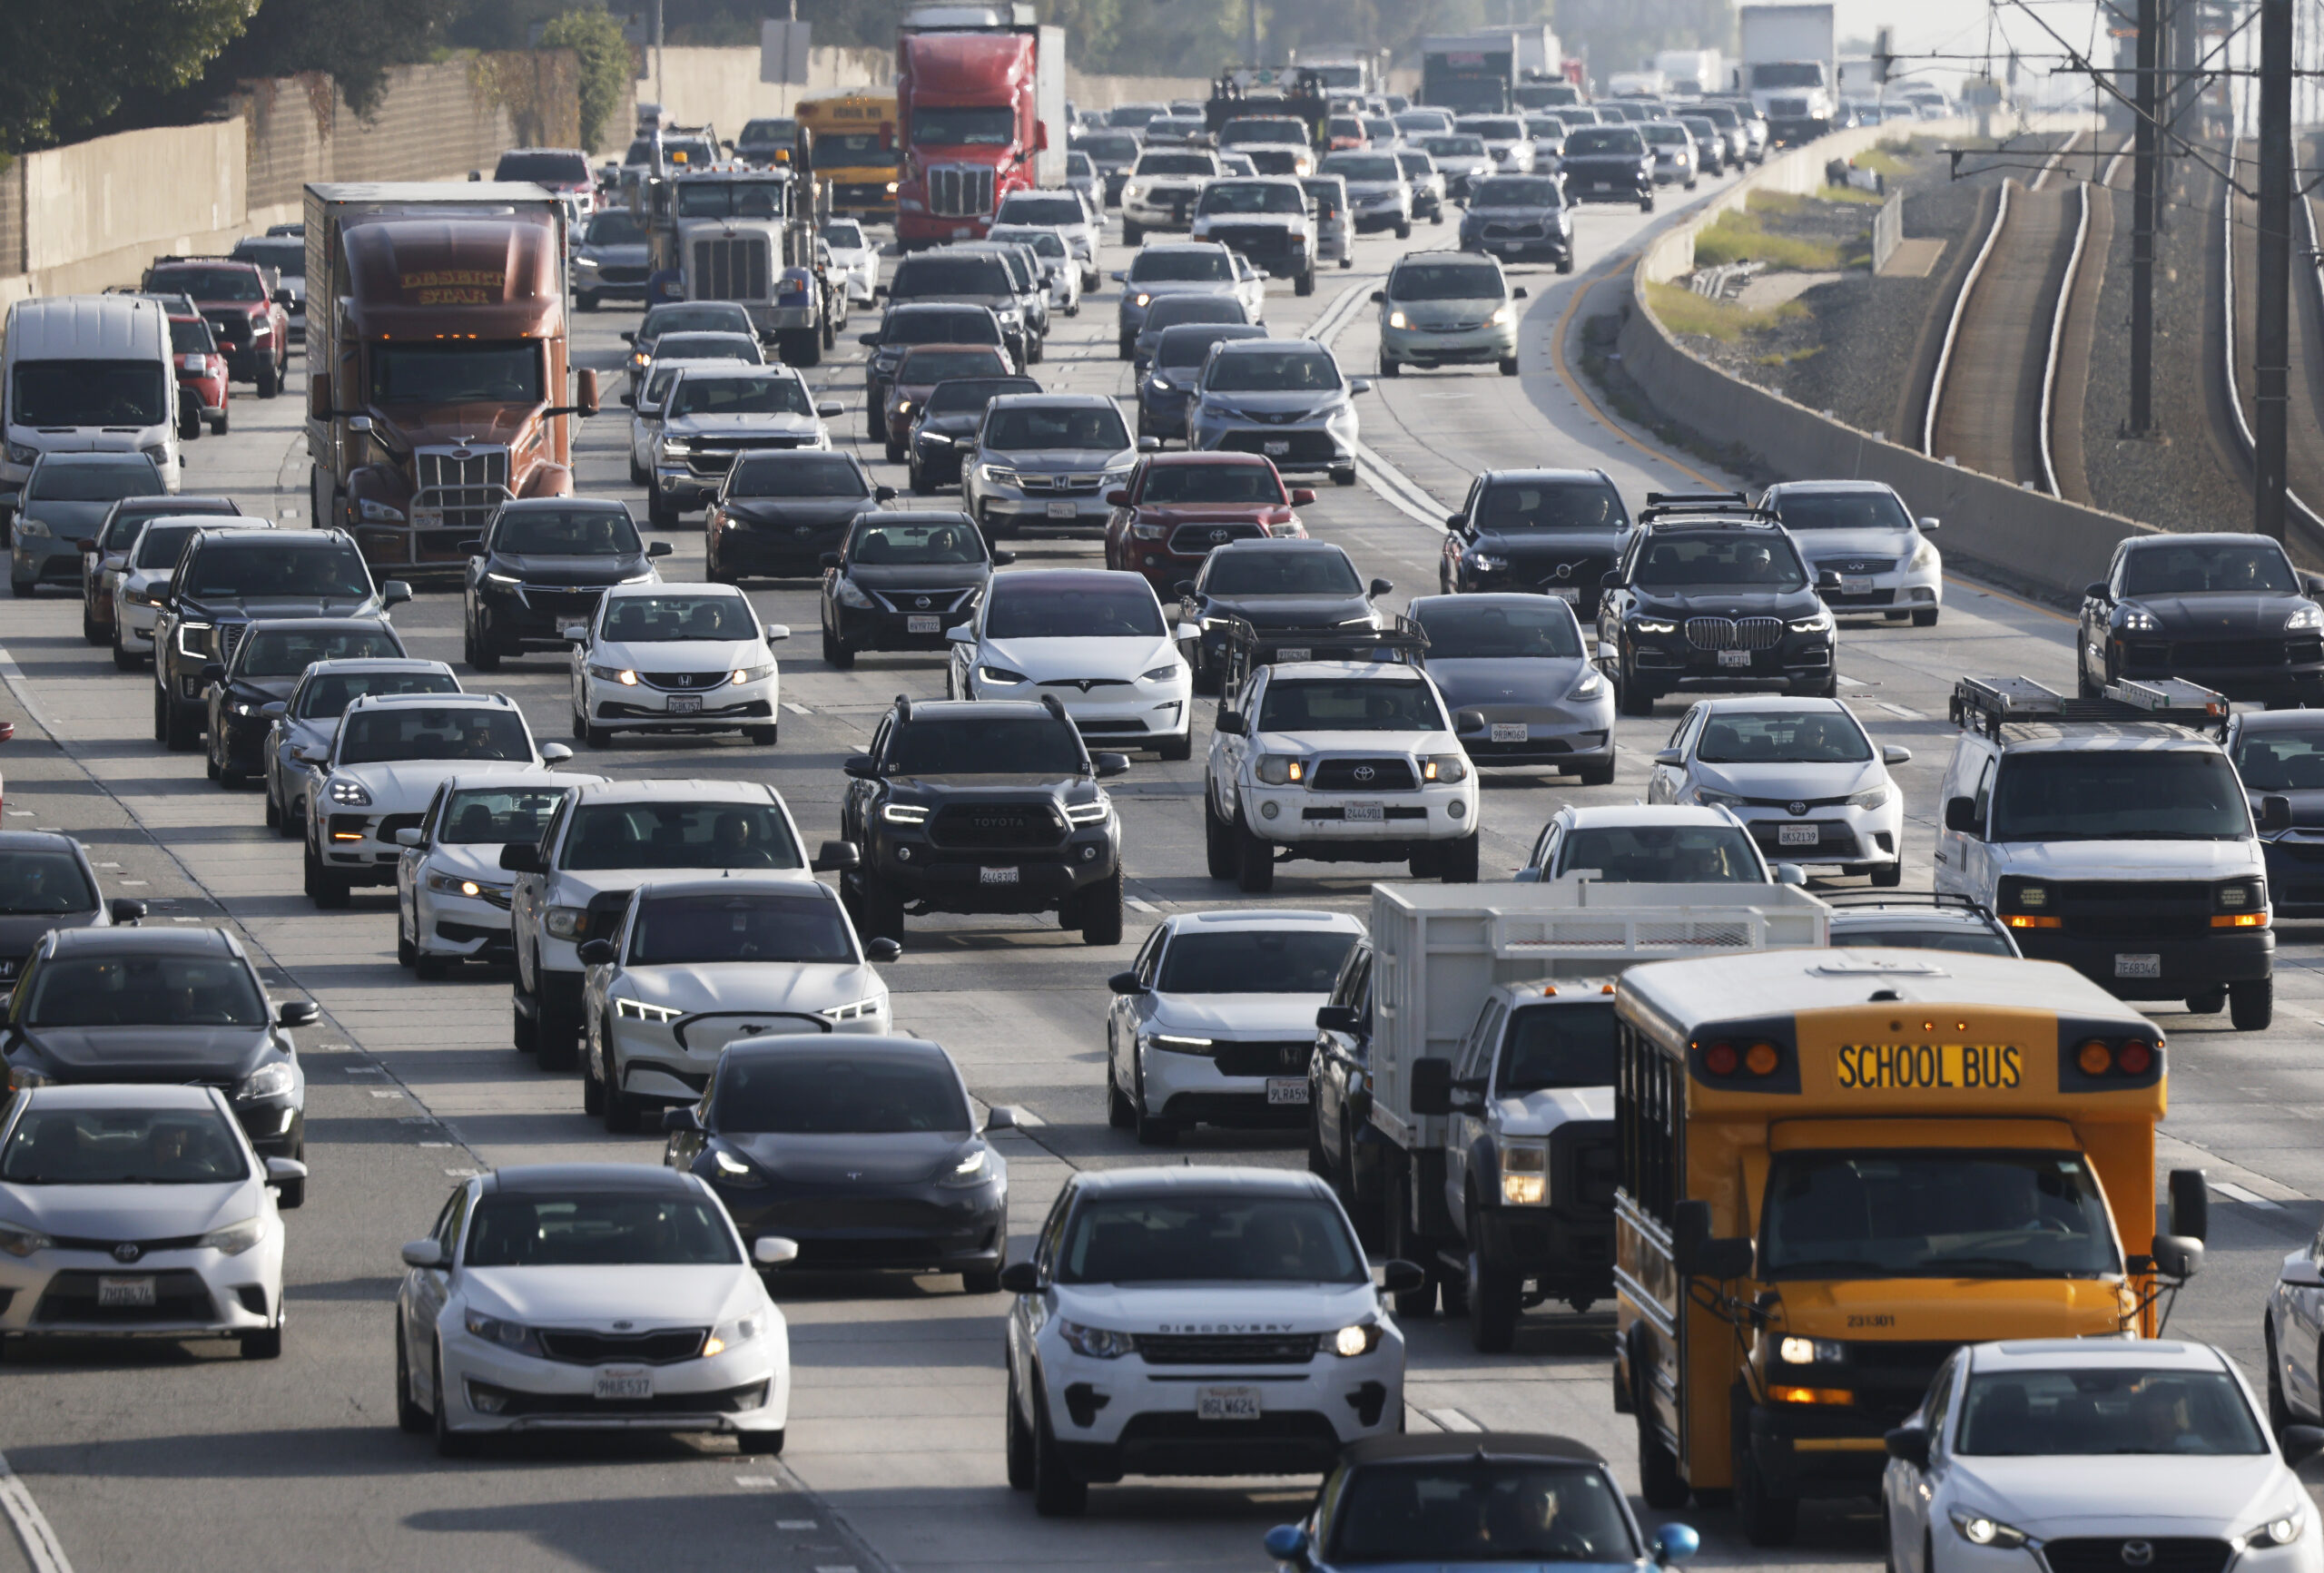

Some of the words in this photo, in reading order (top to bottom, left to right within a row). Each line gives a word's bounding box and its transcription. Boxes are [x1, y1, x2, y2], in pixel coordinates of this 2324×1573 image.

[400, 270, 505, 289] DESERT
[419, 290, 490, 305] STAR
[972, 818, 1024, 827] TOYOTA
[1838, 1046, 1954, 1088] SCHOOL
[1963, 1046, 2020, 1088] BUS
[1271, 1088, 1307, 1100] 9LRA59
[1158, 1323, 1294, 1332] DISCOVERY
